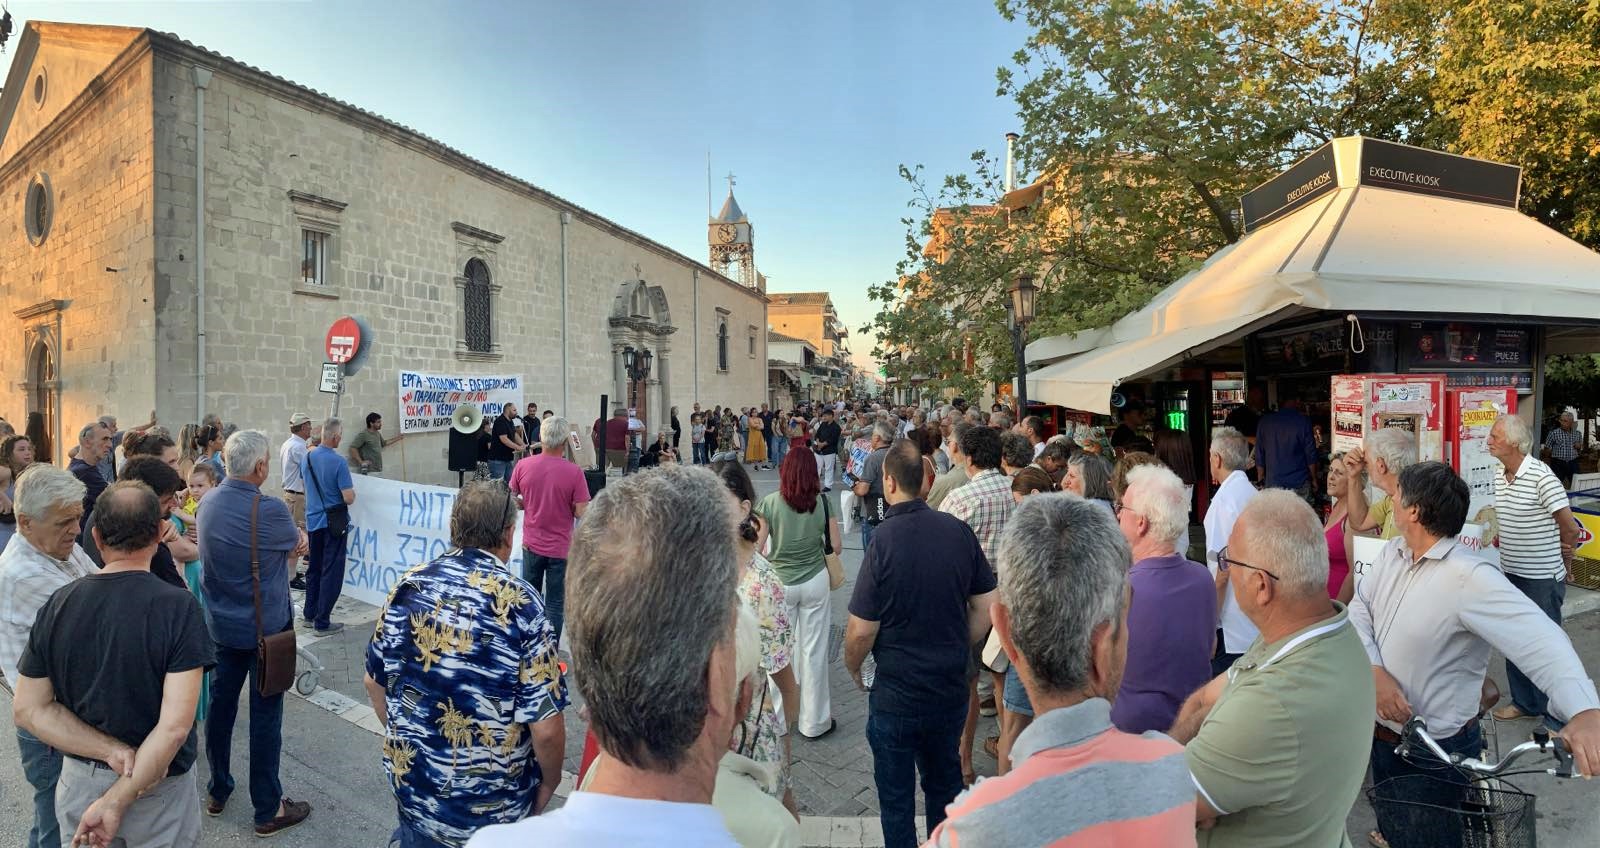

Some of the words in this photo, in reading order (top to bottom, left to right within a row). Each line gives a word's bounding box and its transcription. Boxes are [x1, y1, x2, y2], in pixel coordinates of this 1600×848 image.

[1287, 179, 1313, 203] EXECUTIVE
[1313, 170, 1331, 189] KIOSK
[1369, 166, 1414, 183] EXECUTIVE
[1416, 174, 1440, 187] KIOSK
[402, 373, 422, 388] ΕΡΓΑ
